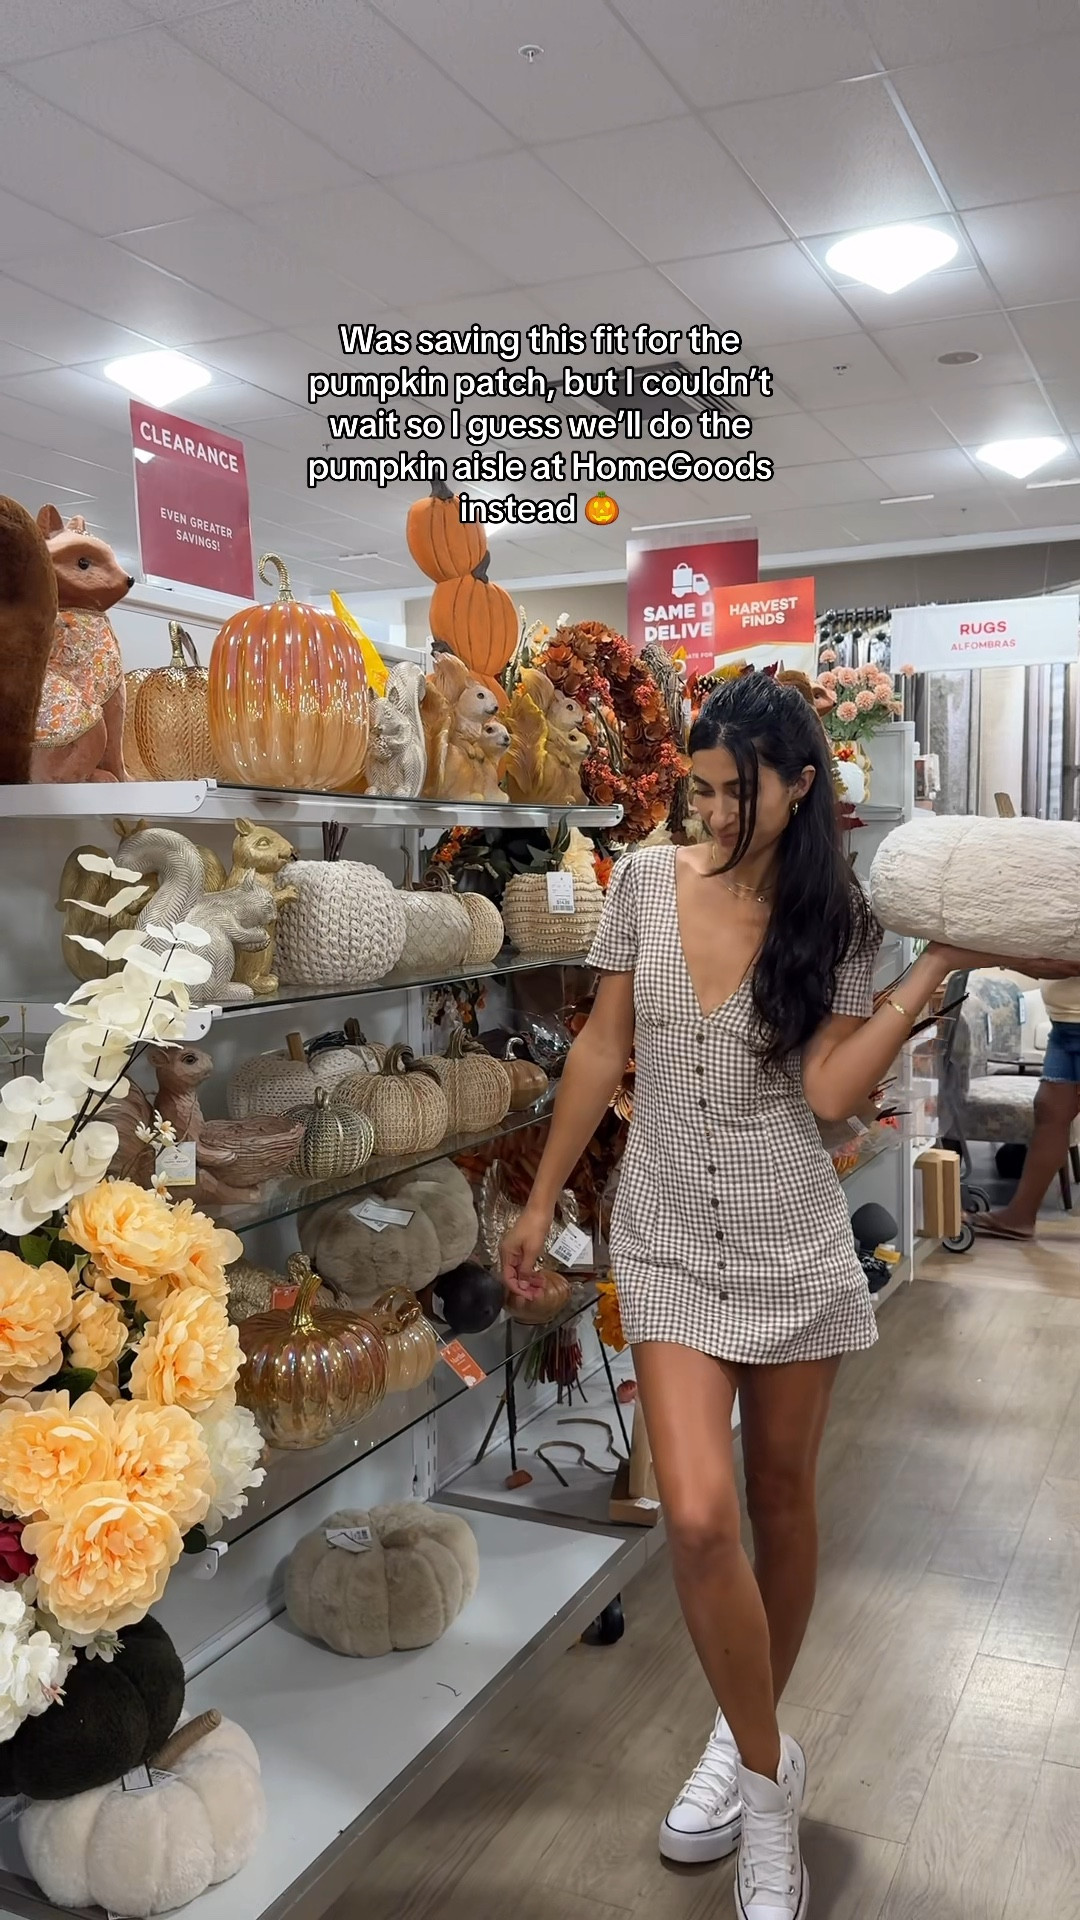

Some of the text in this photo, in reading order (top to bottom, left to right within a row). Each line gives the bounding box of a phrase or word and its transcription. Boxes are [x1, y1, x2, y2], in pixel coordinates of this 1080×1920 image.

[139, 421, 239, 473] CLEARANCE
[160, 507, 233, 539] EVEN GREATER
[176, 529, 221, 552] SAVINGS!
[643, 603, 696, 622] SAME
[729, 596, 798, 617] HARVEST
[741, 611, 785, 628] FINDS
[960, 620, 1007, 636] RUGS
[950, 639, 1016, 651] ALFOMBRAS
